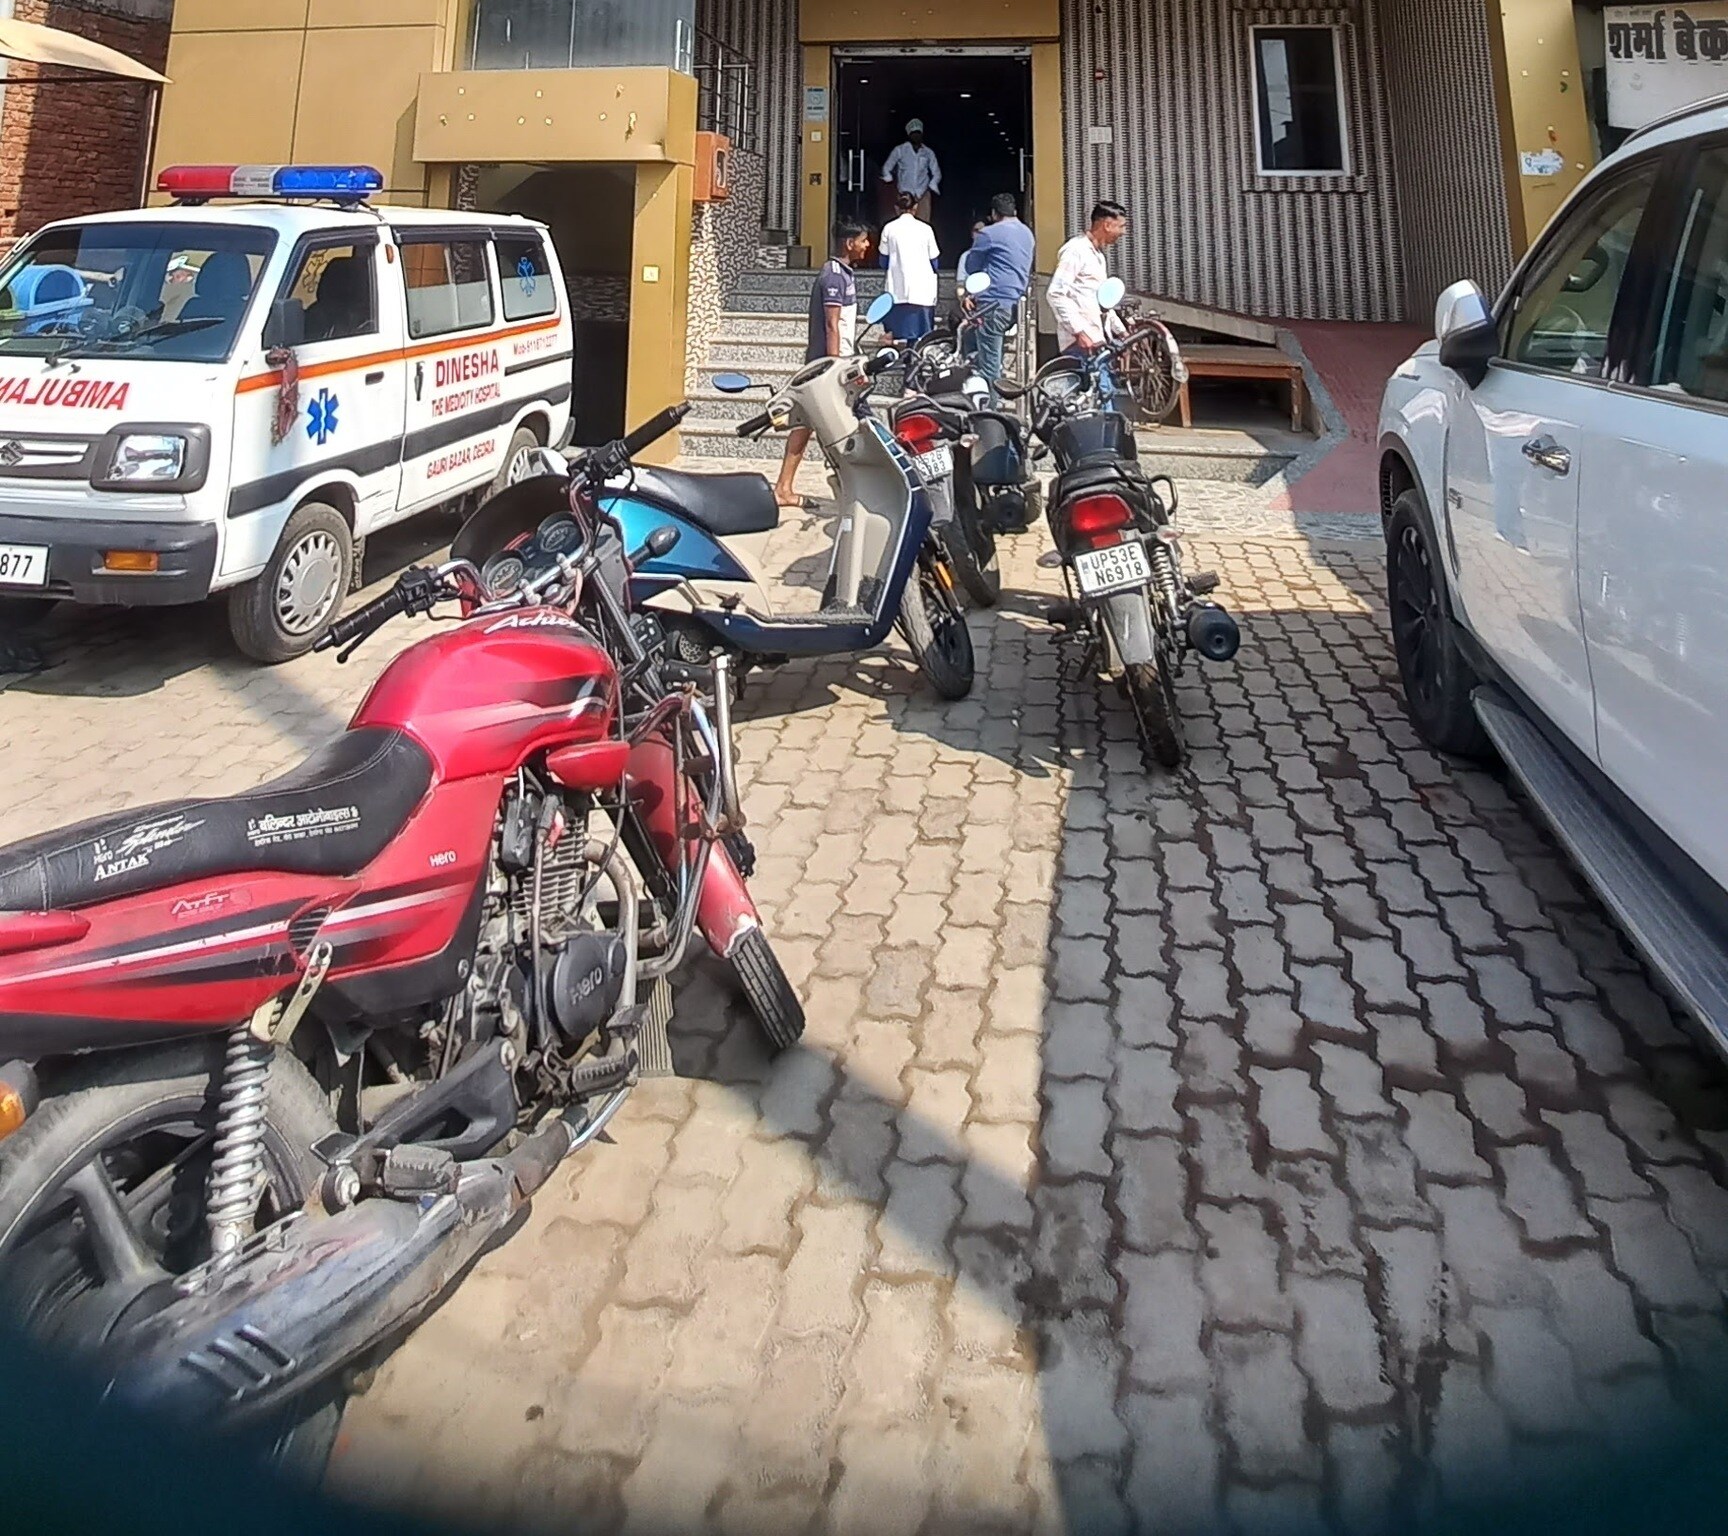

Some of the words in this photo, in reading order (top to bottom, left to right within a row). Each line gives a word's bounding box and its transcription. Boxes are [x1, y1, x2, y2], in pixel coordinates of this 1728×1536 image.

[1607, 9, 1667, 61] शर्मा
[435, 348, 500, 388] DINESHA
[431, 397, 444, 419] THE
[1089, 544, 1138, 570] UP53E
[1094, 561, 1144, 587] N6918
[93, 853, 150, 882] ANTAK
